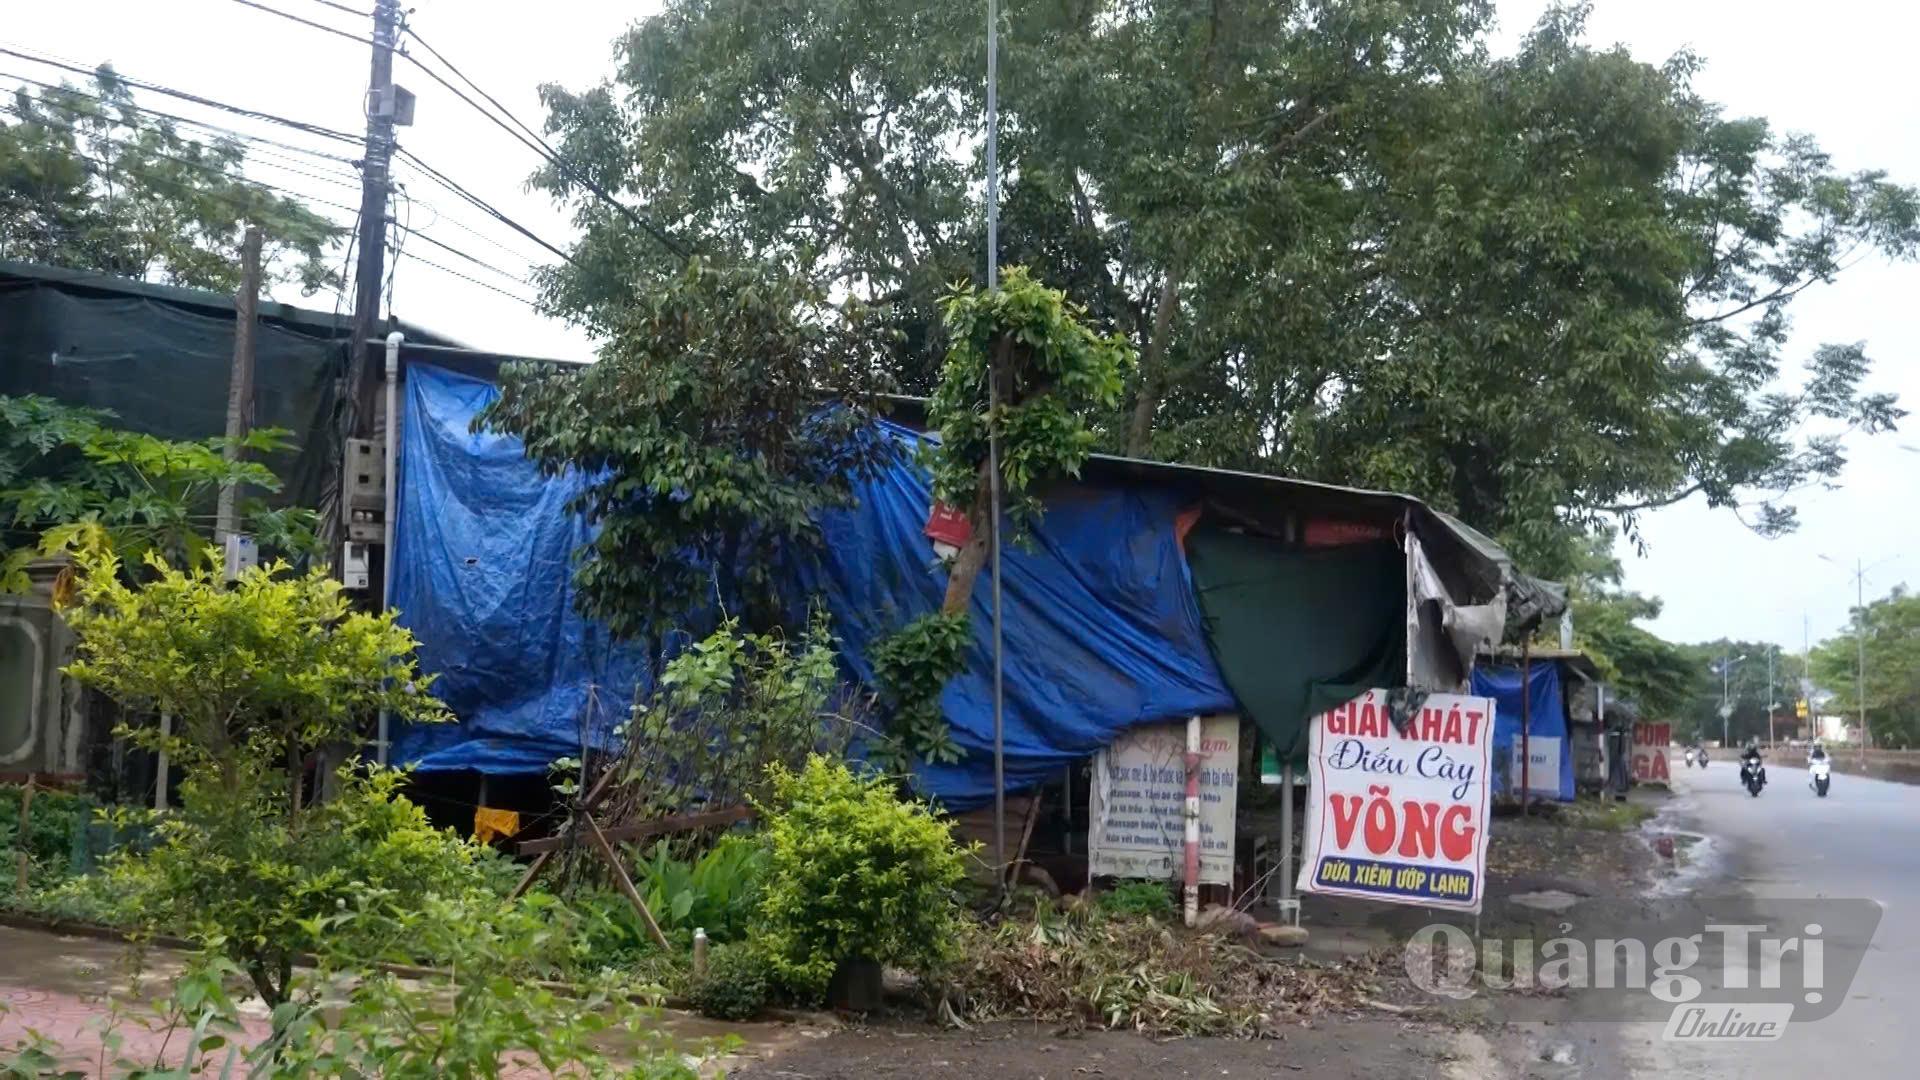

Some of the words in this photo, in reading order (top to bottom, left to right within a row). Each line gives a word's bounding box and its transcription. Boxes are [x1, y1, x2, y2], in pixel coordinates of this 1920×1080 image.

[1327, 691, 1389, 738] GIẢI
[1328, 739, 1409, 775] Điếu
[1416, 746, 1476, 800] Cày
[1329, 784, 1476, 862] VÕNG
[1354, 863, 1393, 888] XIÊM
[1429, 872, 1470, 896] LẠNH
